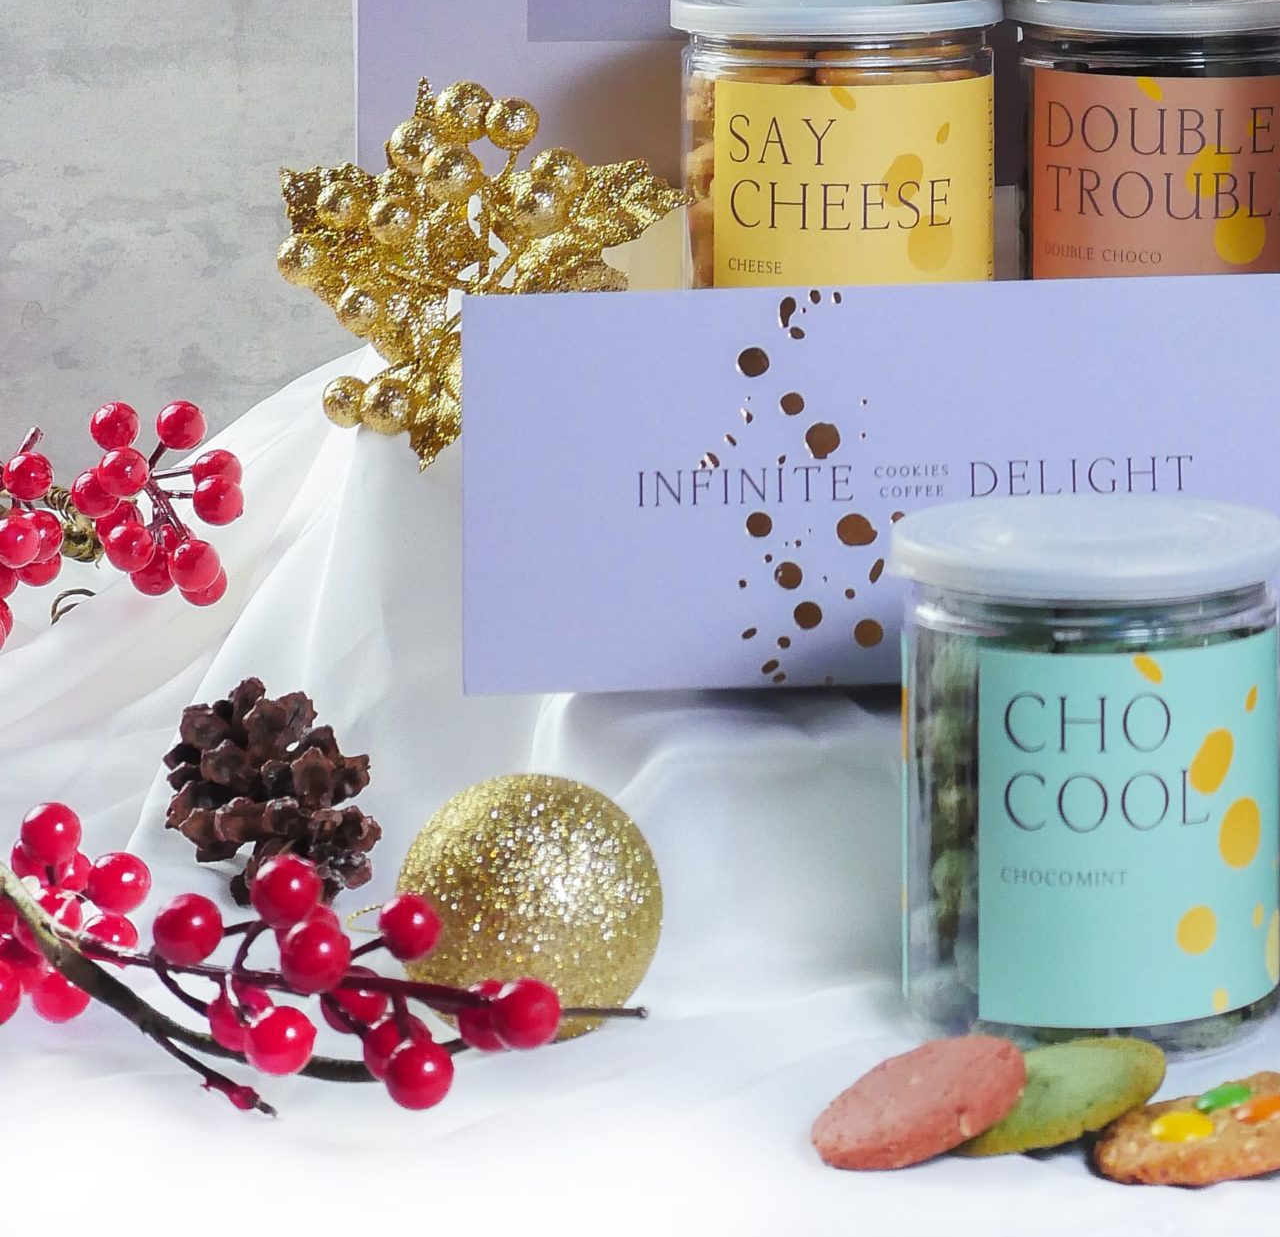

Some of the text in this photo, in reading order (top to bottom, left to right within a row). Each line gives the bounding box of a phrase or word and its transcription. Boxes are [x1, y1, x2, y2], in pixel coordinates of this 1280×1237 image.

[729, 114, 838, 166] SAY
[1046, 101, 1276, 156] DOUBLE
[730, 178, 952, 231] CHEESE
[728, 257, 783, 275] CHEESE
[1044, 240, 1162, 264] DOUBLE CHOCO
[637, 464, 855, 508] INFINITE
[873, 463, 950, 478] COOKIES
[879, 483, 944, 499] COFFEE
[969, 454, 1194, 498] DELIGHT
[1004, 691, 1171, 753] CHO
[1004, 769, 1211, 833] COOL
[1001, 867, 1128, 887] CHOCOMINT
